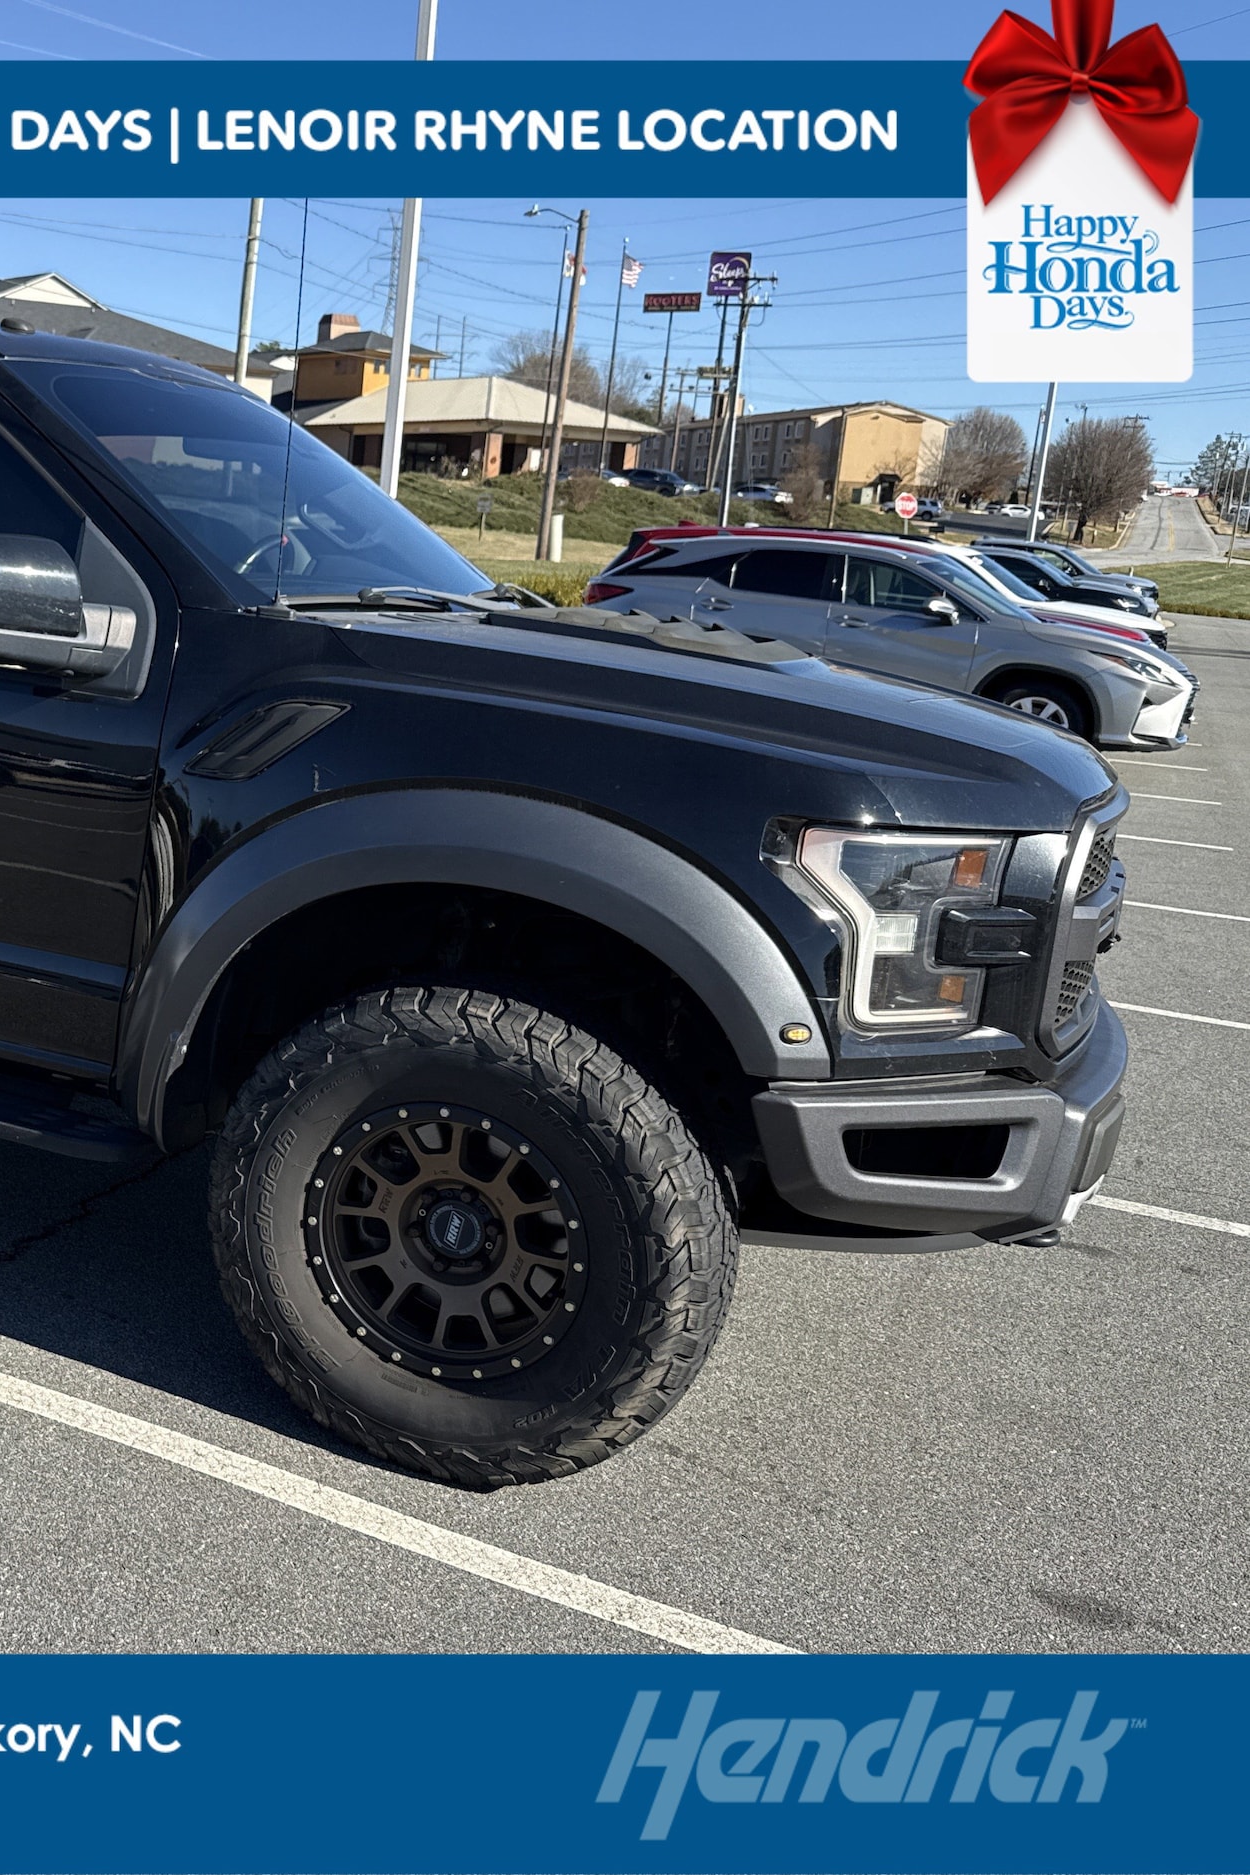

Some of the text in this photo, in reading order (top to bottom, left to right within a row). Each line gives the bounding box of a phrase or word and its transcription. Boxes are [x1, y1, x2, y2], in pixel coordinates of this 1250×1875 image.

[645, 294, 699, 307] HOOTERS
[897, 499, 916, 511] STOP
[445, 1213, 462, 1245] RRW
[254, 1128, 342, 1374] BFGoodrich
